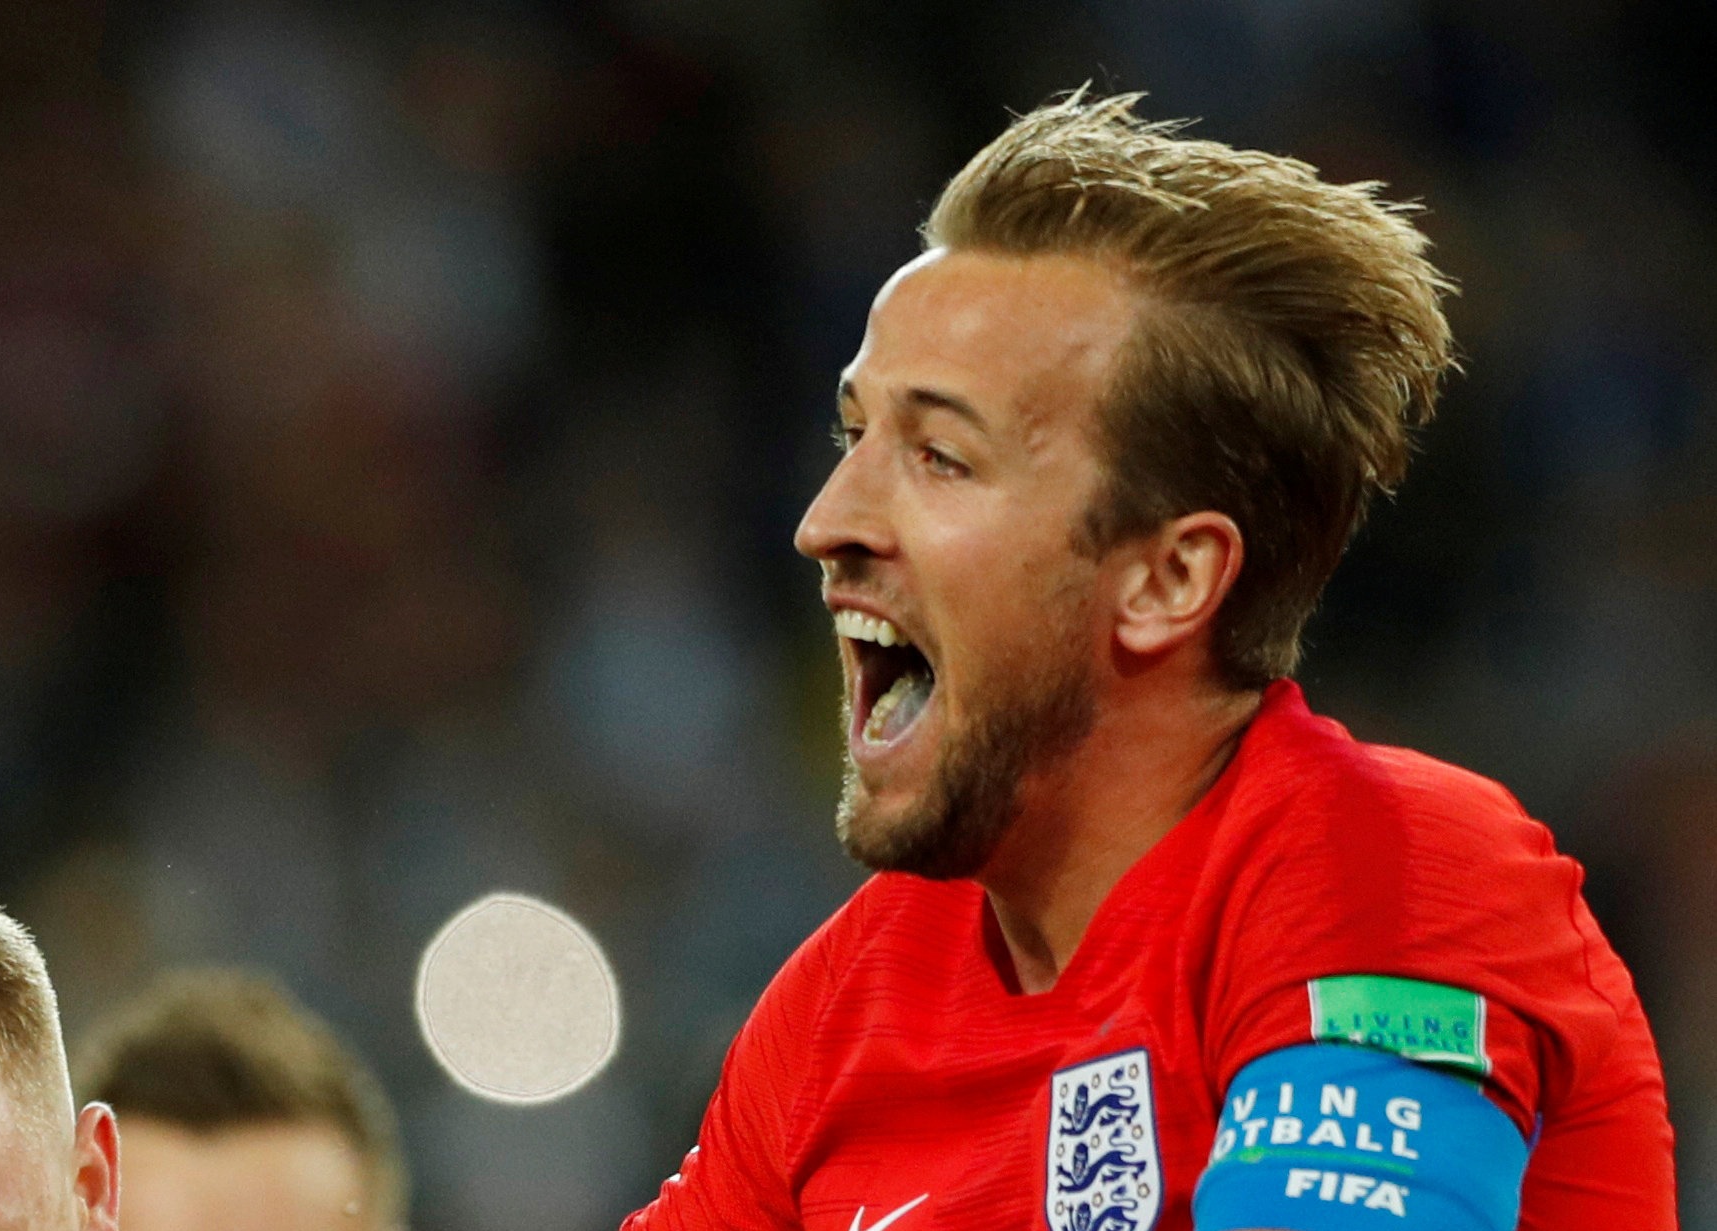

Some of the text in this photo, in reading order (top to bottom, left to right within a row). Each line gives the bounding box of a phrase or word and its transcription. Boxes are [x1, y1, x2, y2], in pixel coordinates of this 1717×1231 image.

[1327, 1013, 1469, 1038] LIVING
[1232, 1082, 1422, 1131] VING
[1212, 1116, 1420, 1160] OTBALL
[1285, 1168, 1408, 1217] FIFA
